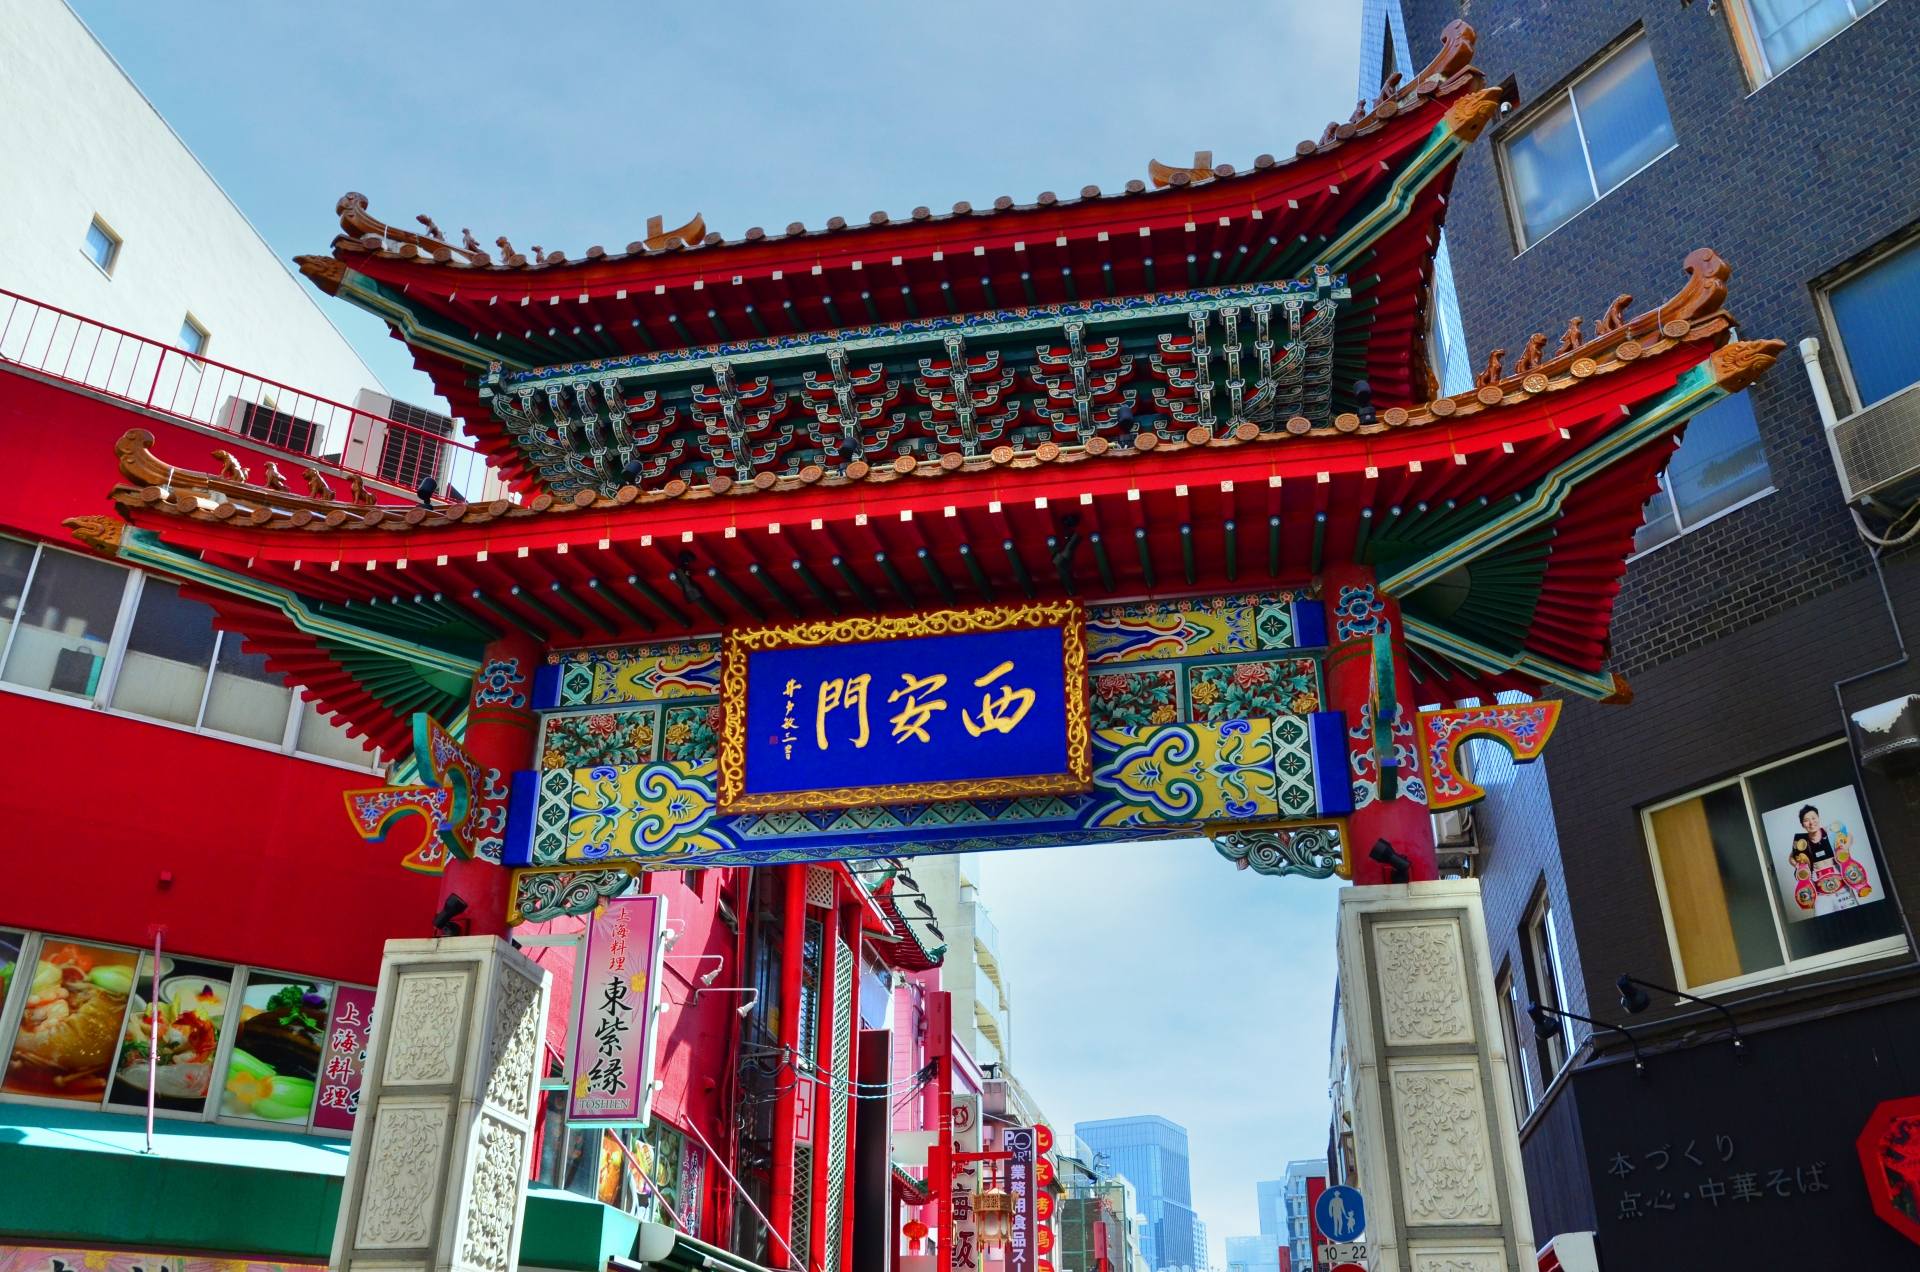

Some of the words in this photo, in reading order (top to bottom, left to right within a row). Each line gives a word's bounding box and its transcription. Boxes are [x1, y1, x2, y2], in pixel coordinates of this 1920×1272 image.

[608, 907, 631, 972] 上海料理
[320, 1002, 361, 1109] 上海料理
[586, 976, 634, 1096] 東紫縁
[579, 1099, 631, 1110] TOSHIEN
[1608, 1134, 1734, 1179] 本づくり
